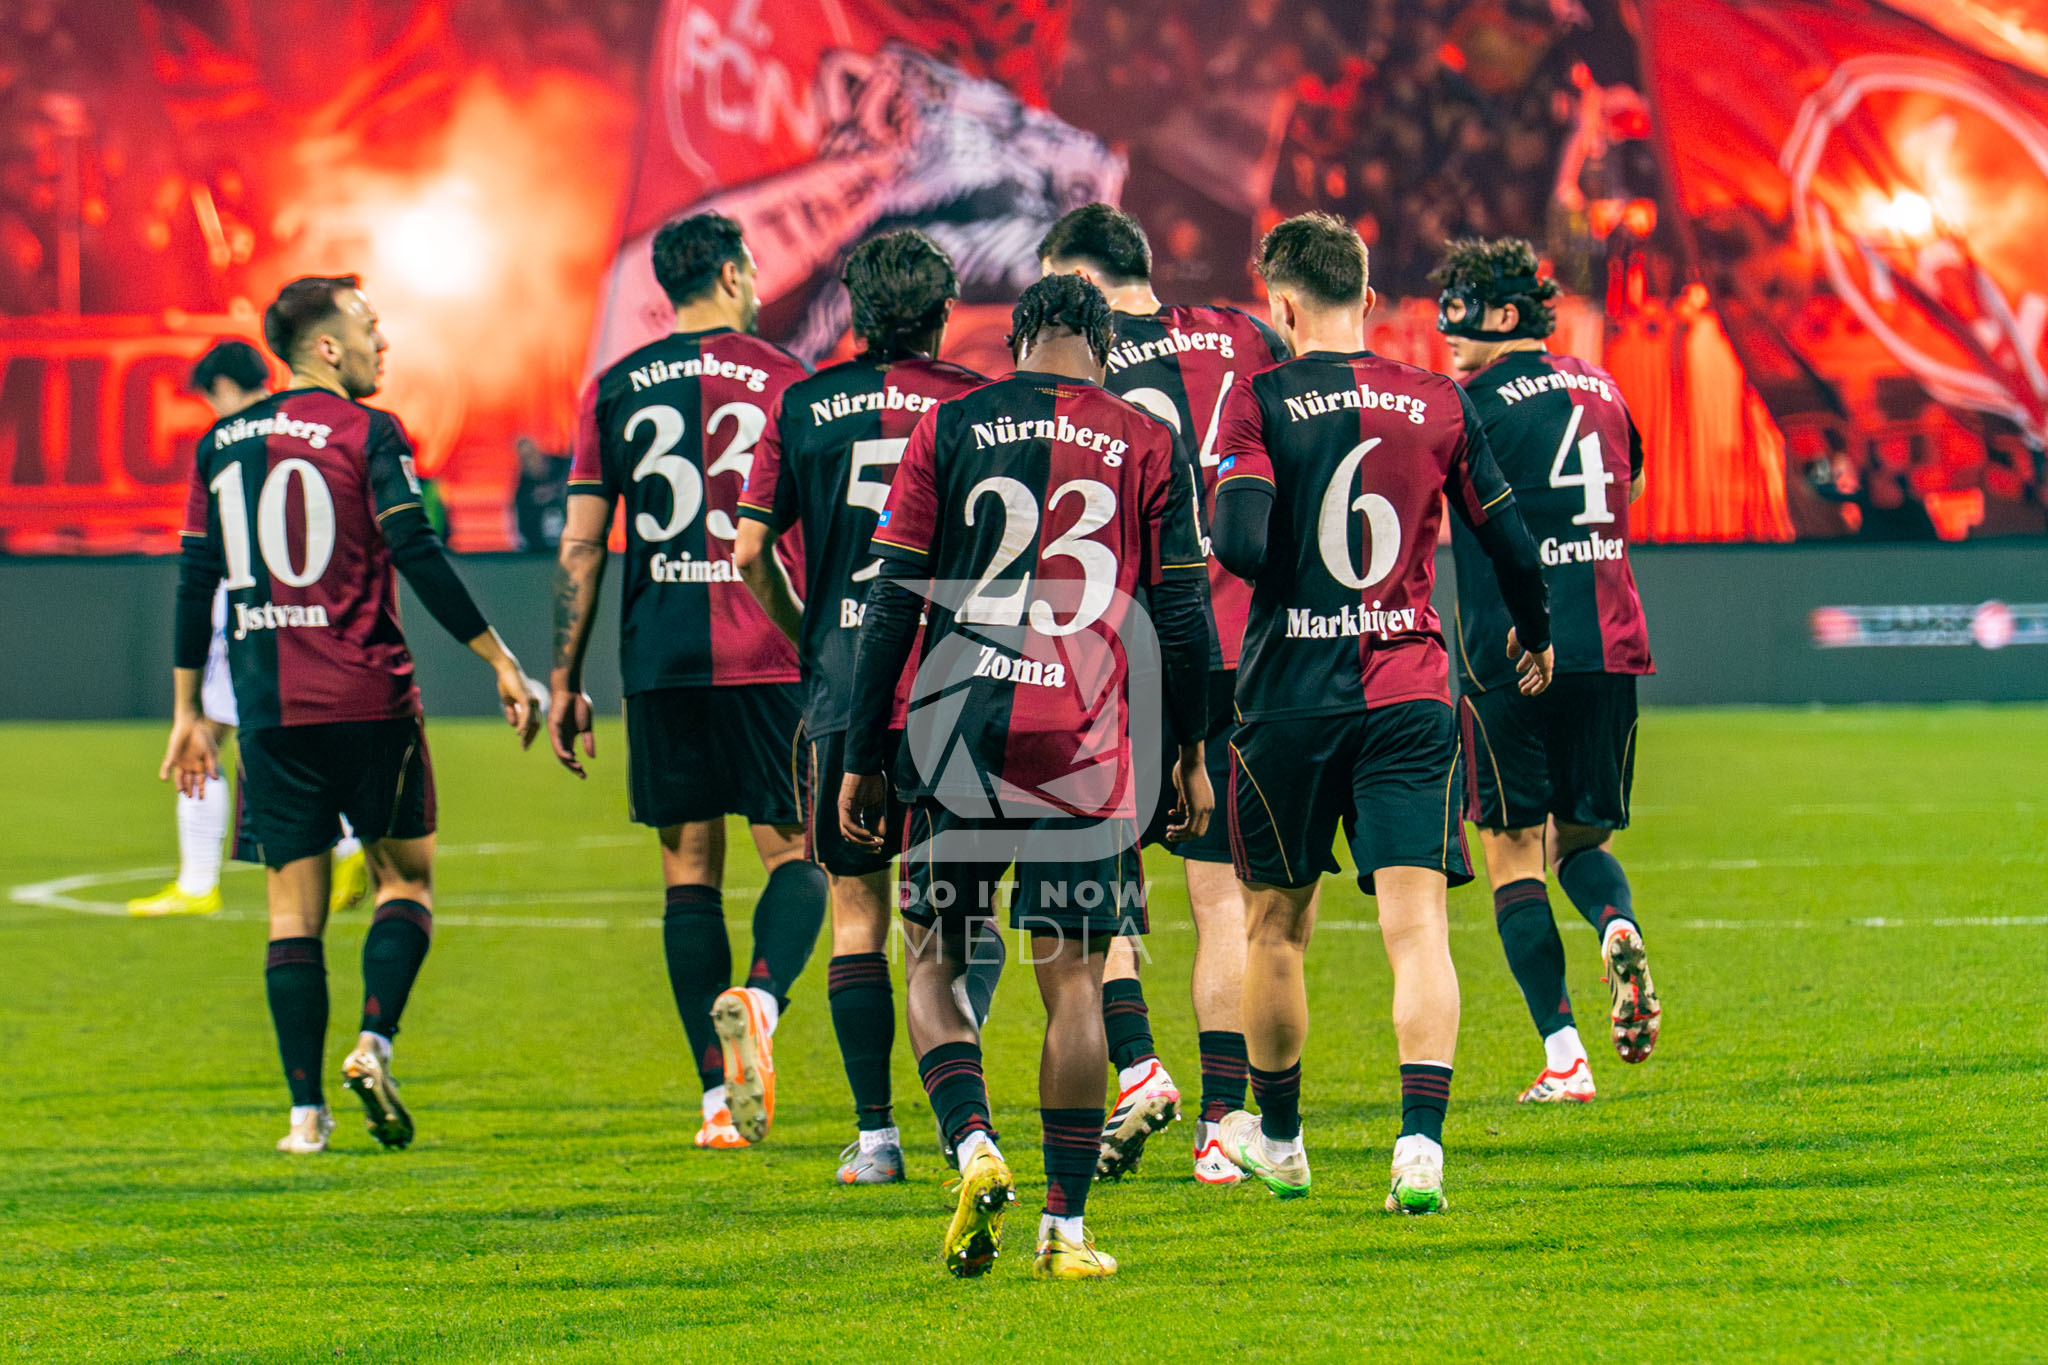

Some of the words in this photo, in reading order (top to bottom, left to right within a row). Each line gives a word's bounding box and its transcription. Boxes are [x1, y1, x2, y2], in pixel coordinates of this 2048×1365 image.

[1107, 328, 1235, 374] Nürnberg
[629, 353, 769, 393] Nürnberg
[1496, 370, 1613, 406] Nürnberg
[810, 385, 938, 427] Nürnber
[1284, 384, 1427, 424] Nürnberg
[214, 412, 333, 450] Nürnberg
[971, 416, 1129, 467] Nürnberg
[624, 402, 767, 543] 33
[1549, 405, 1615, 526] 4
[209, 458, 336, 590] 10
[847, 437, 910, 582] 5
[1318, 437, 1401, 589] 6
[650, 551, 744, 583] Grimal
[954, 476, 1118, 636] 23
[1540, 531, 1624, 567] Gruber
[1285, 600, 1416, 640] Markhiyev
[973, 645, 1066, 688] Zoma
